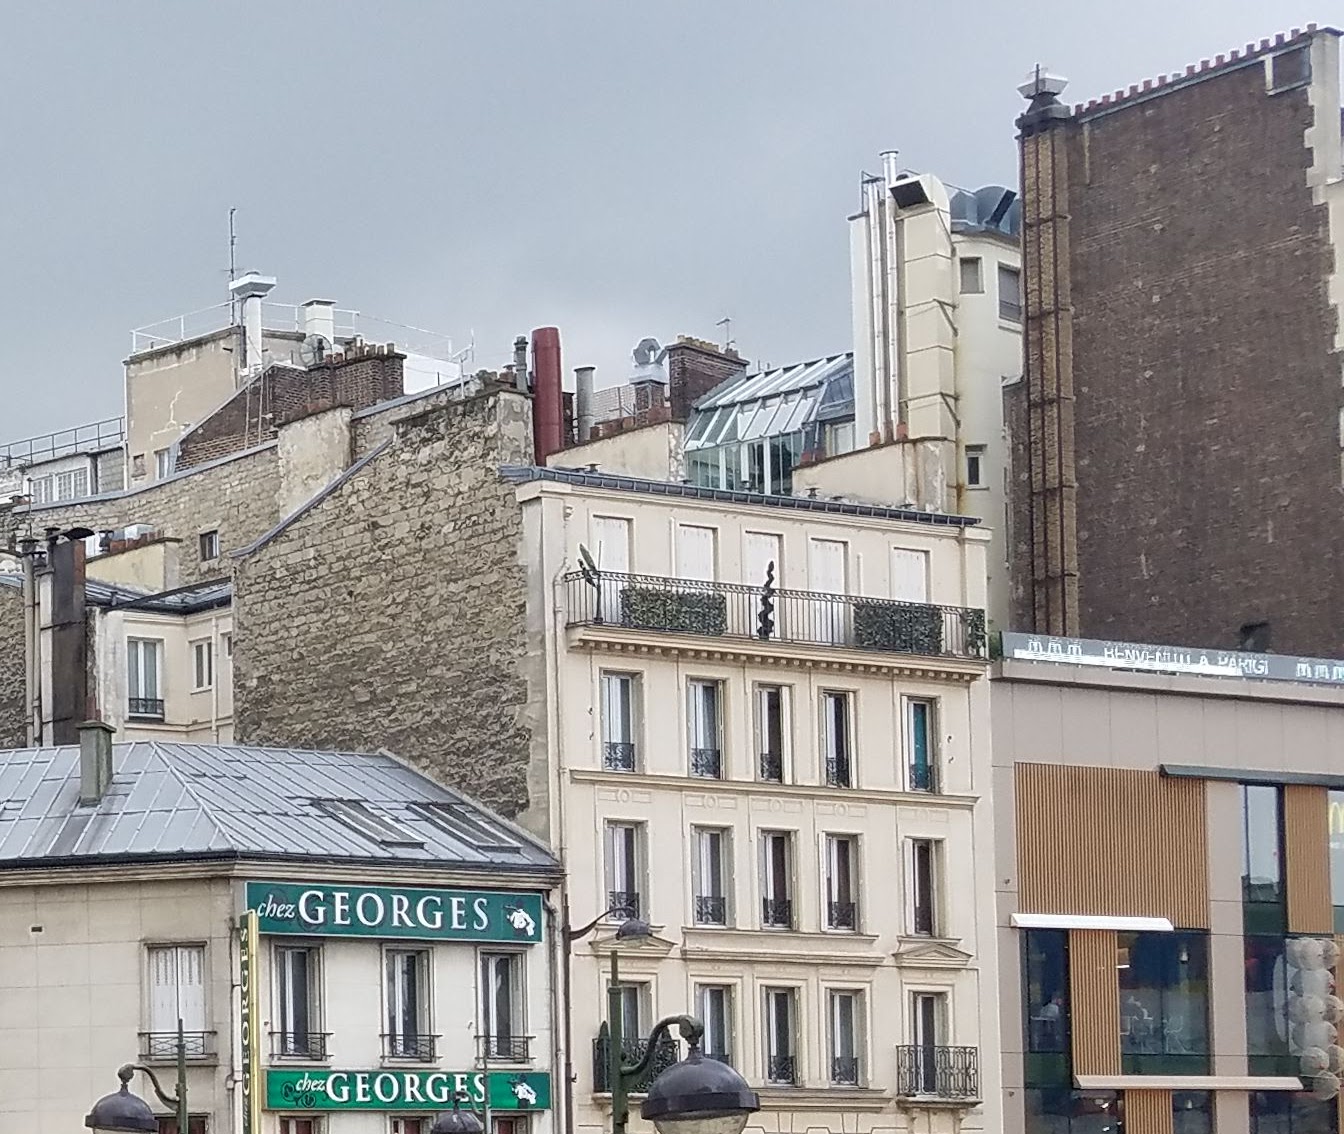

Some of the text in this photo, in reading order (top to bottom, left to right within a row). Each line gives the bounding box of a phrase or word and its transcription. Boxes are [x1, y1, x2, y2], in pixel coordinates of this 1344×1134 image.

[257, 890, 490, 931] chez GEORGES
[240, 927, 251, 1097] GEORGES
[295, 1073, 487, 1103] chez GEORGES
